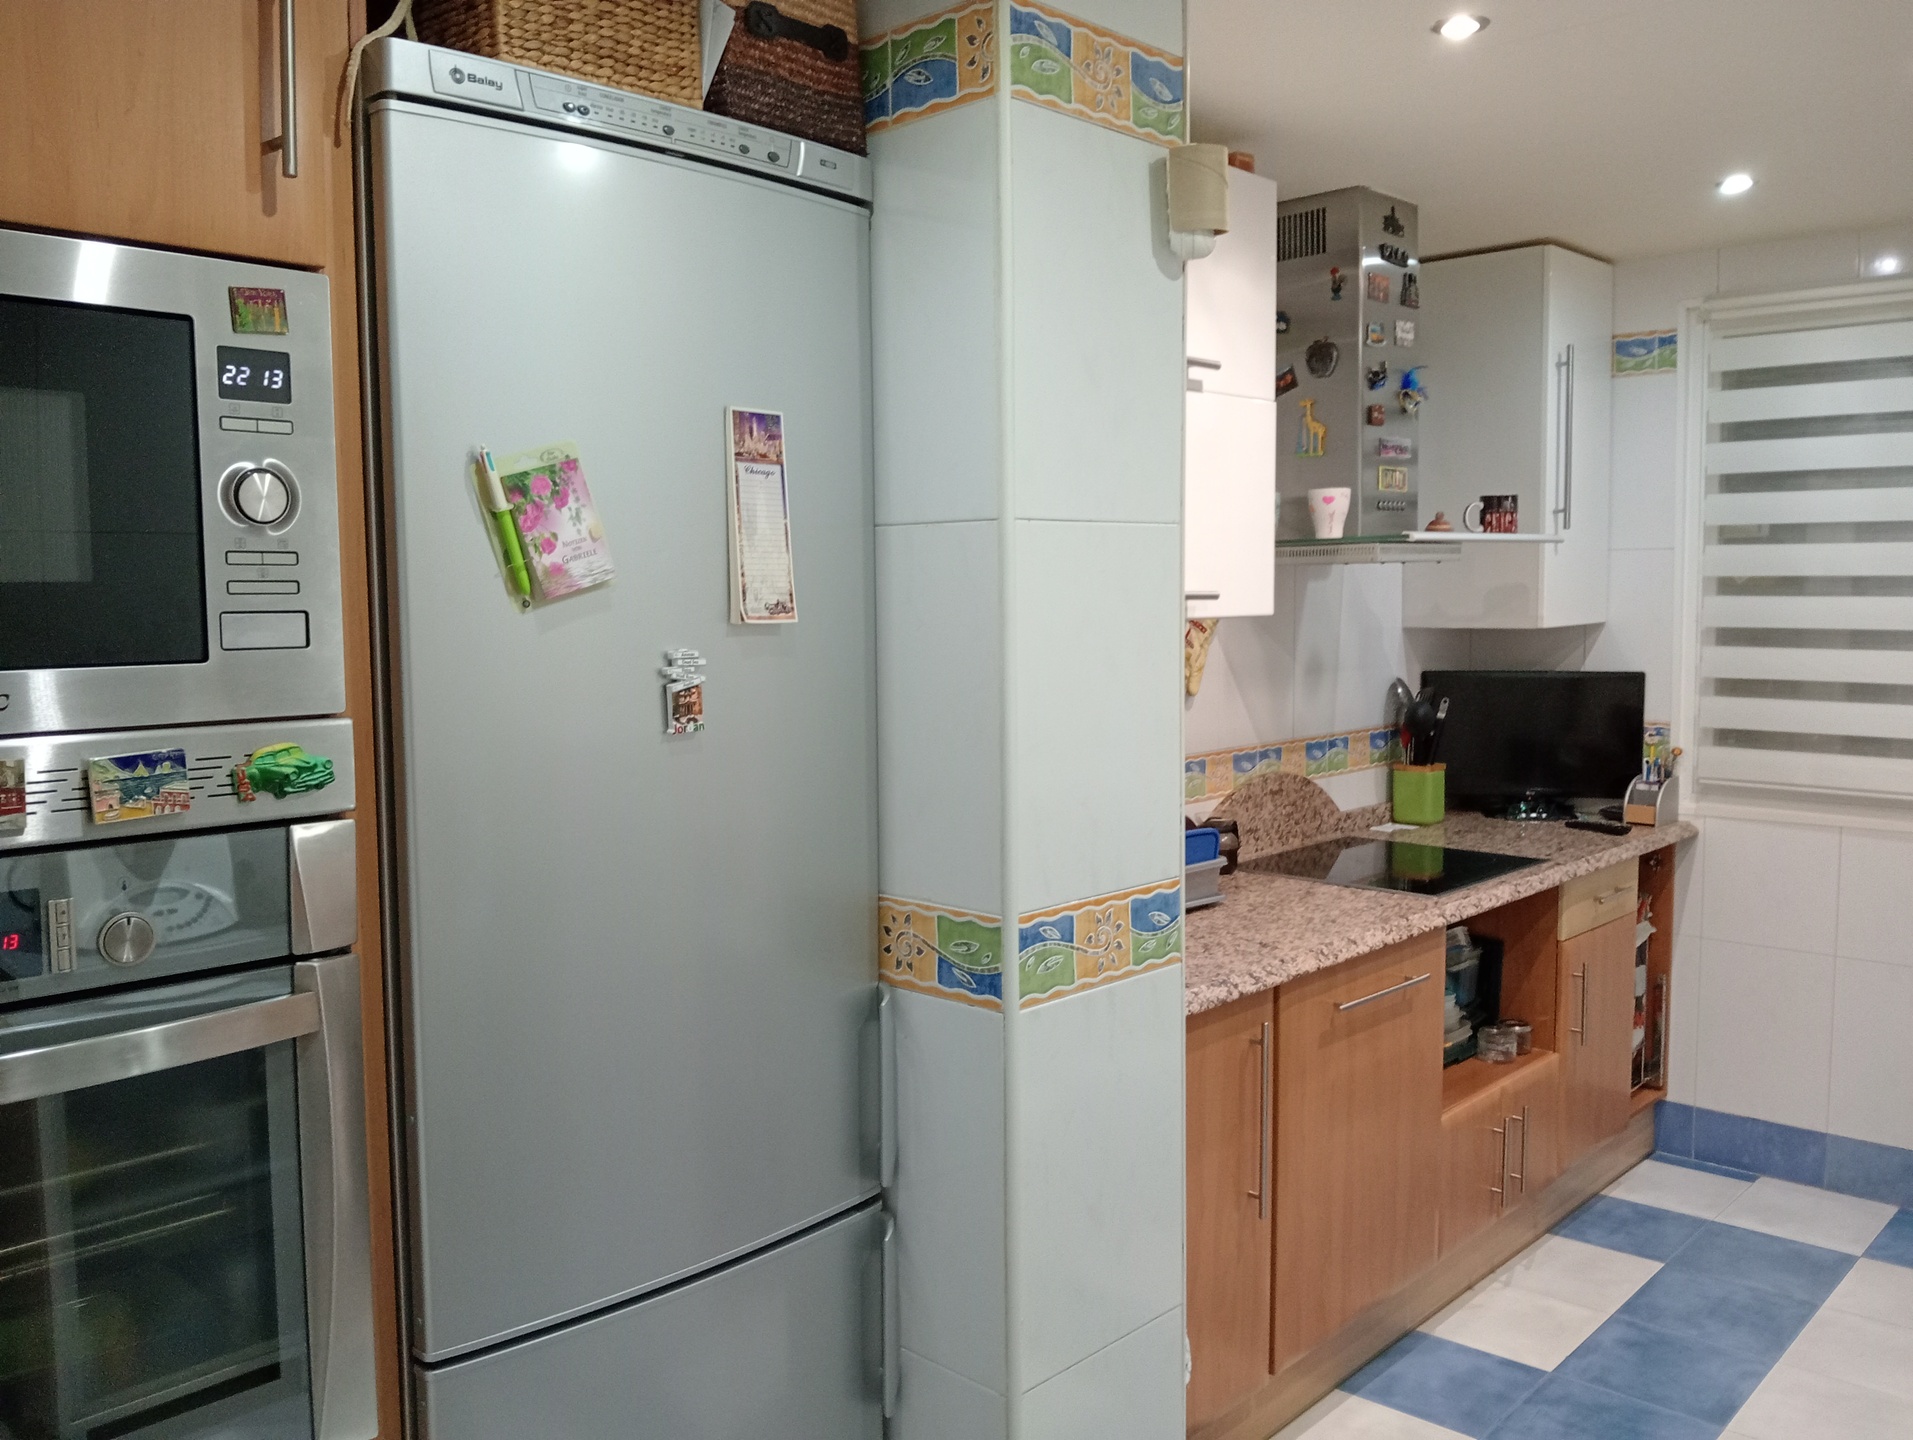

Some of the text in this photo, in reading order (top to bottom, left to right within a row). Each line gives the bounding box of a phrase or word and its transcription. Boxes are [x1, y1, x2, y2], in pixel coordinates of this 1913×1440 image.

[467, 72, 503, 91] Balay
[222, 365, 283, 389] 22 13
[744, 464, 776, 479] Chicago
[672, 723, 705, 735] Jordan
[3, 934, 19, 950] 13
